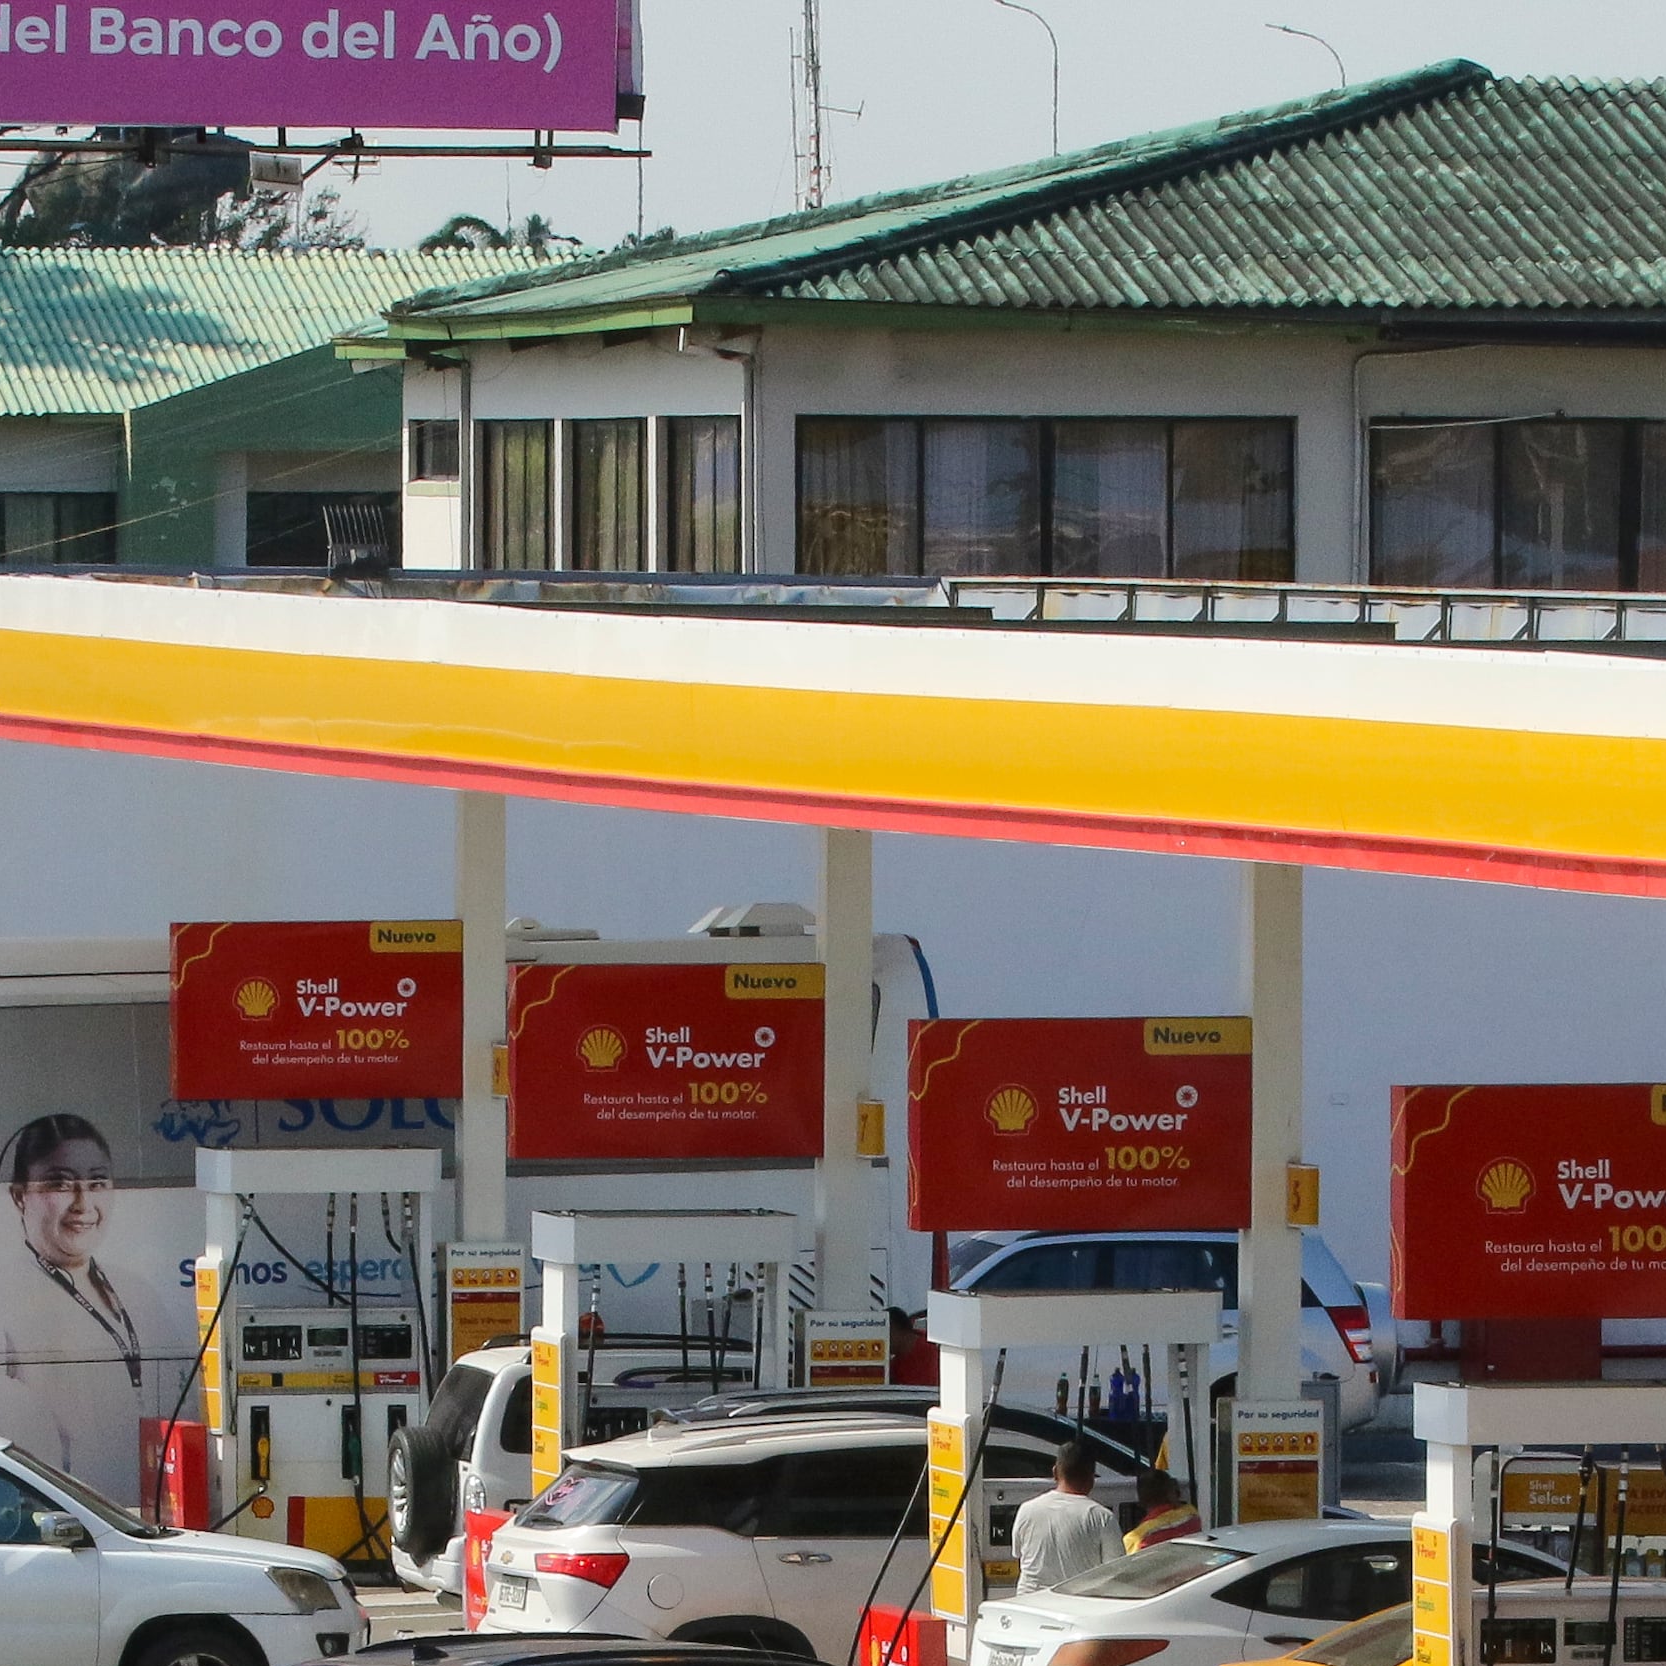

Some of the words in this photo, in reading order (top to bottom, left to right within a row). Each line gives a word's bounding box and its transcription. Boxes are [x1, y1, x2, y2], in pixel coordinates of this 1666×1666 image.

[90, 10, 283, 59] Banco
[303, 9, 396, 61] del
[416, 12, 563, 73] Año)
[377, 930, 436, 943] Nuevo
[296, 978, 338, 995] Shell
[733, 975, 797, 990] Nuevo
[297, 998, 407, 1018] V-Power
[336, 1029, 410, 1050] 100%
[645, 1027, 690, 1045] Shell
[1154, 1027, 1221, 1044] Nuevo
[646, 1047, 765, 1069] V-Power
[584, 1093, 634, 1105] Restaura
[637, 1093, 669, 1105] hasta
[673, 1093, 683, 1104] el
[688, 1082, 768, 1105] 100%
[1058, 1086, 1106, 1104] Shell
[597, 1109, 615, 1121] del
[689, 1108, 704, 1120] de
[707, 1110, 719, 1120] tu
[1059, 1108, 1188, 1131] V-Power
[993, 1160, 1046, 1172] Restaura
[1050, 1159, 1085, 1171] hasta
[1089, 1159, 1099, 1170] el
[1104, 1147, 1190, 1170] 100%
[1557, 1159, 1610, 1179] Shell
[1006, 1176, 1026, 1188] del
[1106, 1175, 1123, 1187] de
[1126, 1177, 1138, 1187] tu
[1485, 1240, 1544, 1254] Restaura
[1548, 1239, 1586, 1253] hasta
[1589, 1239, 1602, 1252] el
[1501, 1259, 1522, 1272] del
[1526, 1259, 1606, 1275] desempeño
[1610, 1258, 1628, 1270] de
[1632, 1259, 1644, 1270] tu
[1237, 1410, 1254, 1420] Por
[1257, 1412, 1268, 1420] su
[1271, 1409, 1320, 1422] seguridad
[1528, 1479, 1556, 1491] Shell
[1528, 1492, 1572, 1505] Select
